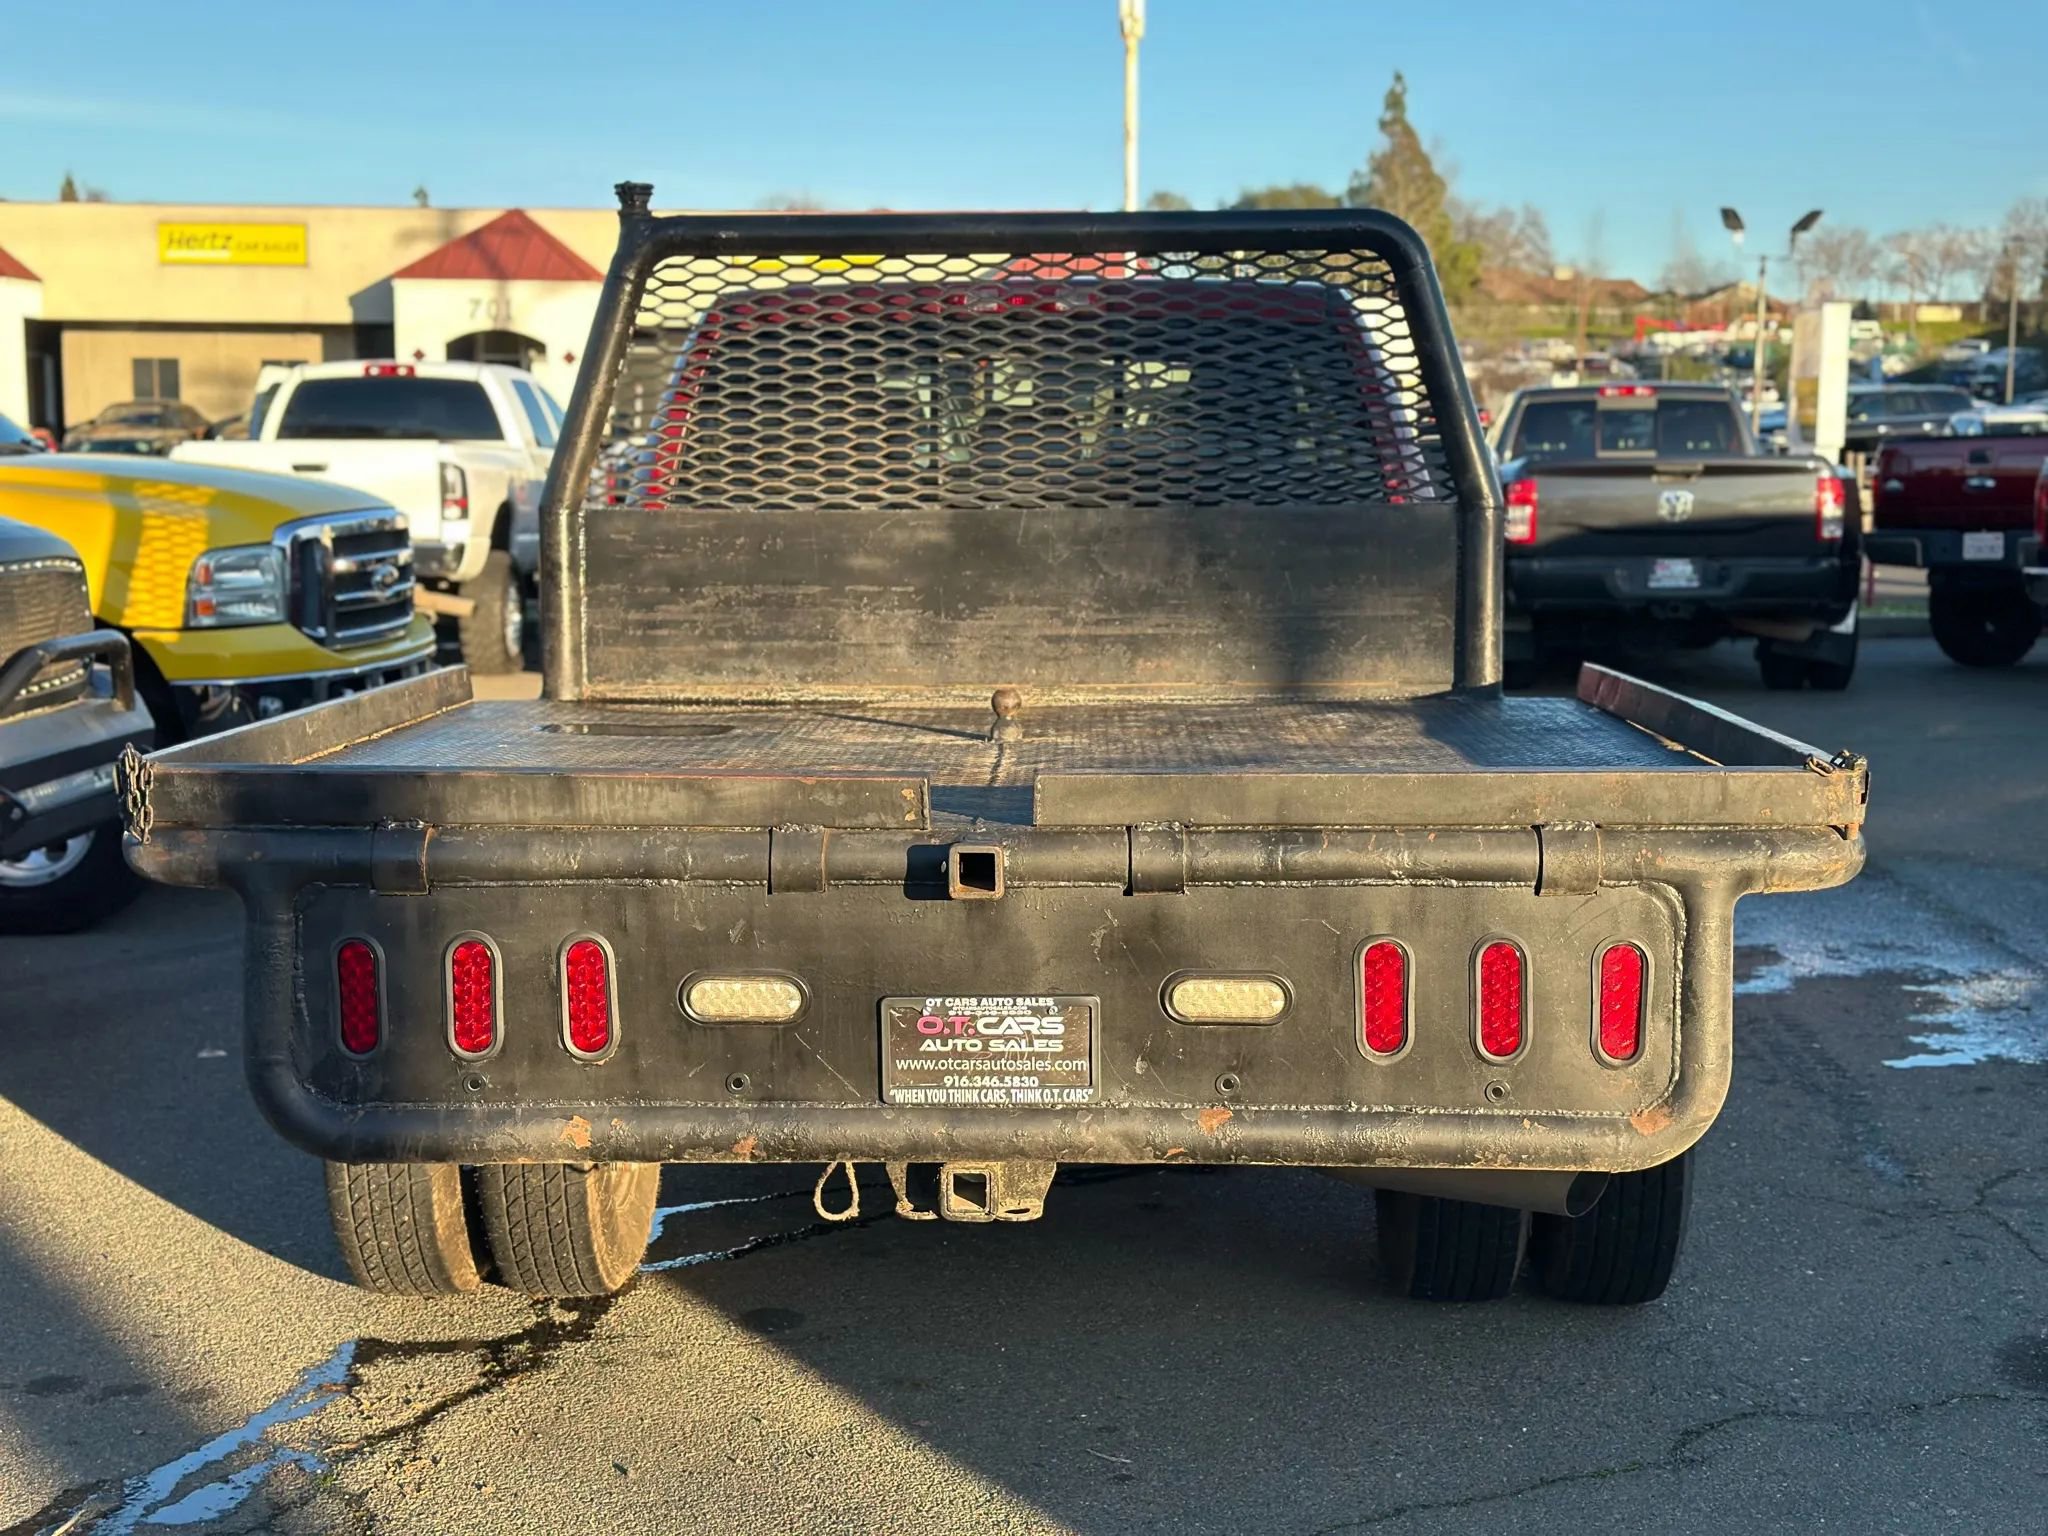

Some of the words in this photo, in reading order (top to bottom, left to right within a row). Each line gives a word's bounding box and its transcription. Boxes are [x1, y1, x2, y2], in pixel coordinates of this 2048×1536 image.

[168, 231, 232, 251] Hertz
[468, 297, 513, 321] 701
[926, 998, 943, 1007] OT
[945, 998, 978, 1007] CARS
[980, 998, 1013, 1007] AUTO
[1016, 998, 1054, 1007] SALES
[919, 1039, 983, 1052] AUTO
[988, 1039, 1064, 1052] SALES
[896, 1057, 1087, 1072] www.otcarsautosales.com
[943, 1075, 1039, 1088] 916.346.5830
[926, 1088, 946, 1104] YOU
[948, 1088, 980, 1104] THINK
[981, 1088, 1010, 1105] CARS,
[1011, 1088, 1042, 1104] THINK
[1043, 1088, 1062, 1104] O.T.
